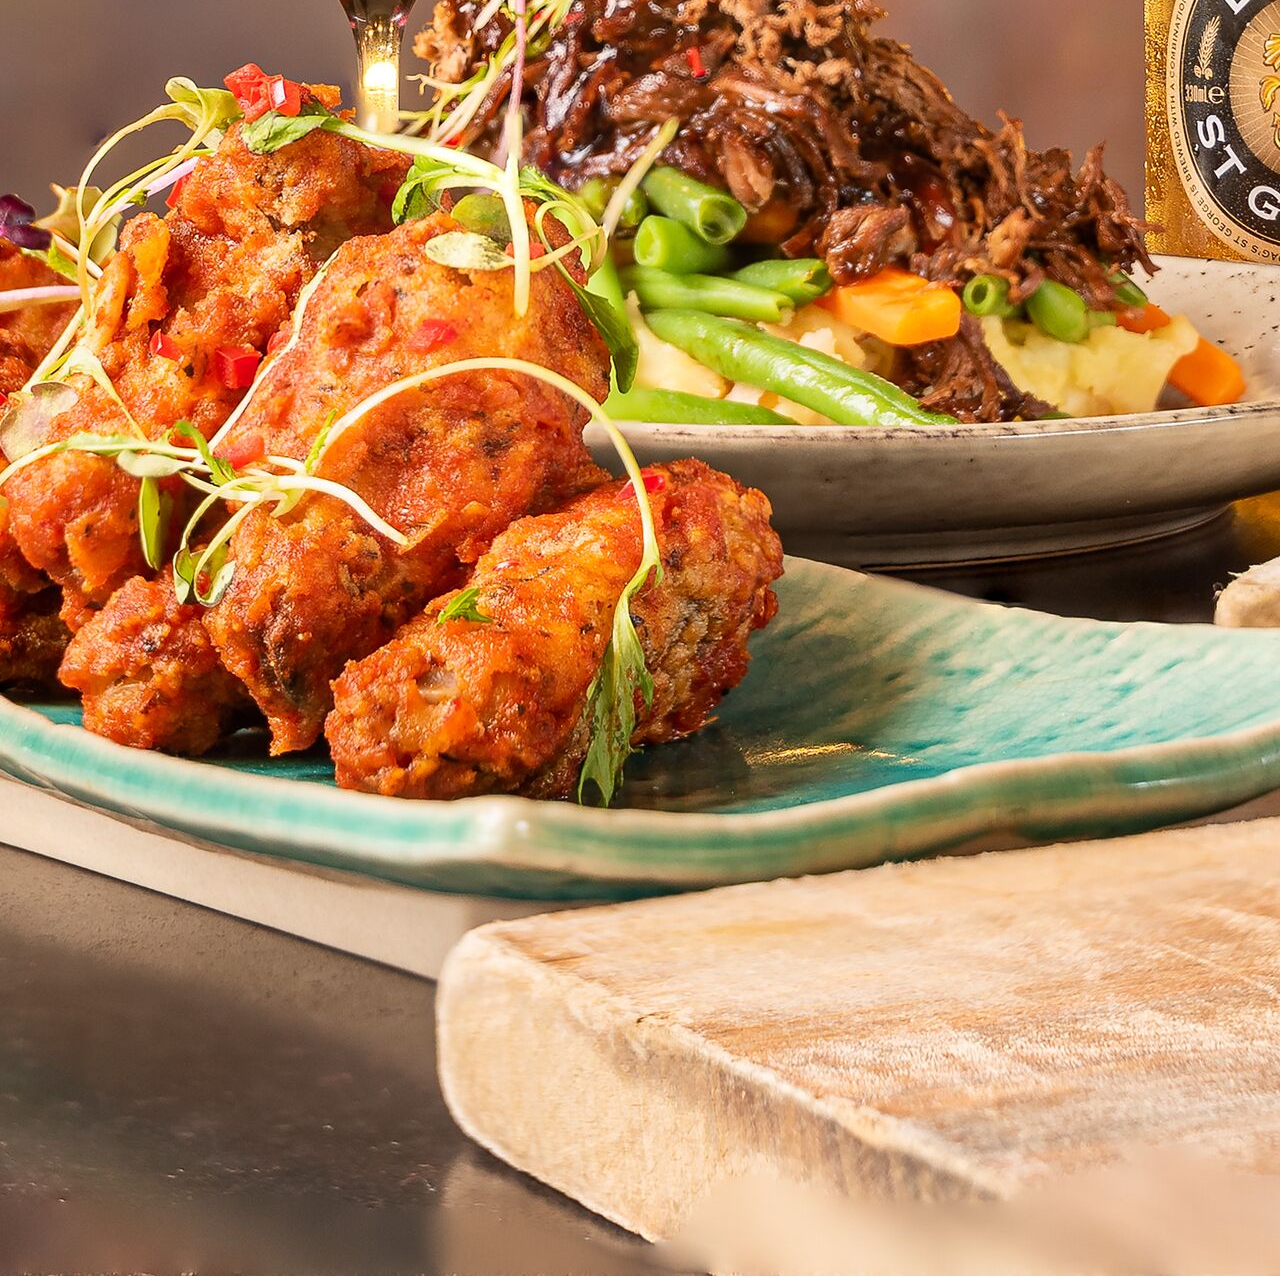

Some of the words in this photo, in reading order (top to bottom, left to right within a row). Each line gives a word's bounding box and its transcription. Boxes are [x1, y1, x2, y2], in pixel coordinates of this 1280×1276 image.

[1170, 95, 1178, 126] WITH
[1173, 131, 1192, 182] BREWED
[1196, 114, 1248, 180] ST
[1189, 184, 1200, 197] IS
[1197, 197, 1233, 237] GEORGE
[1233, 234, 1249, 248] ST
